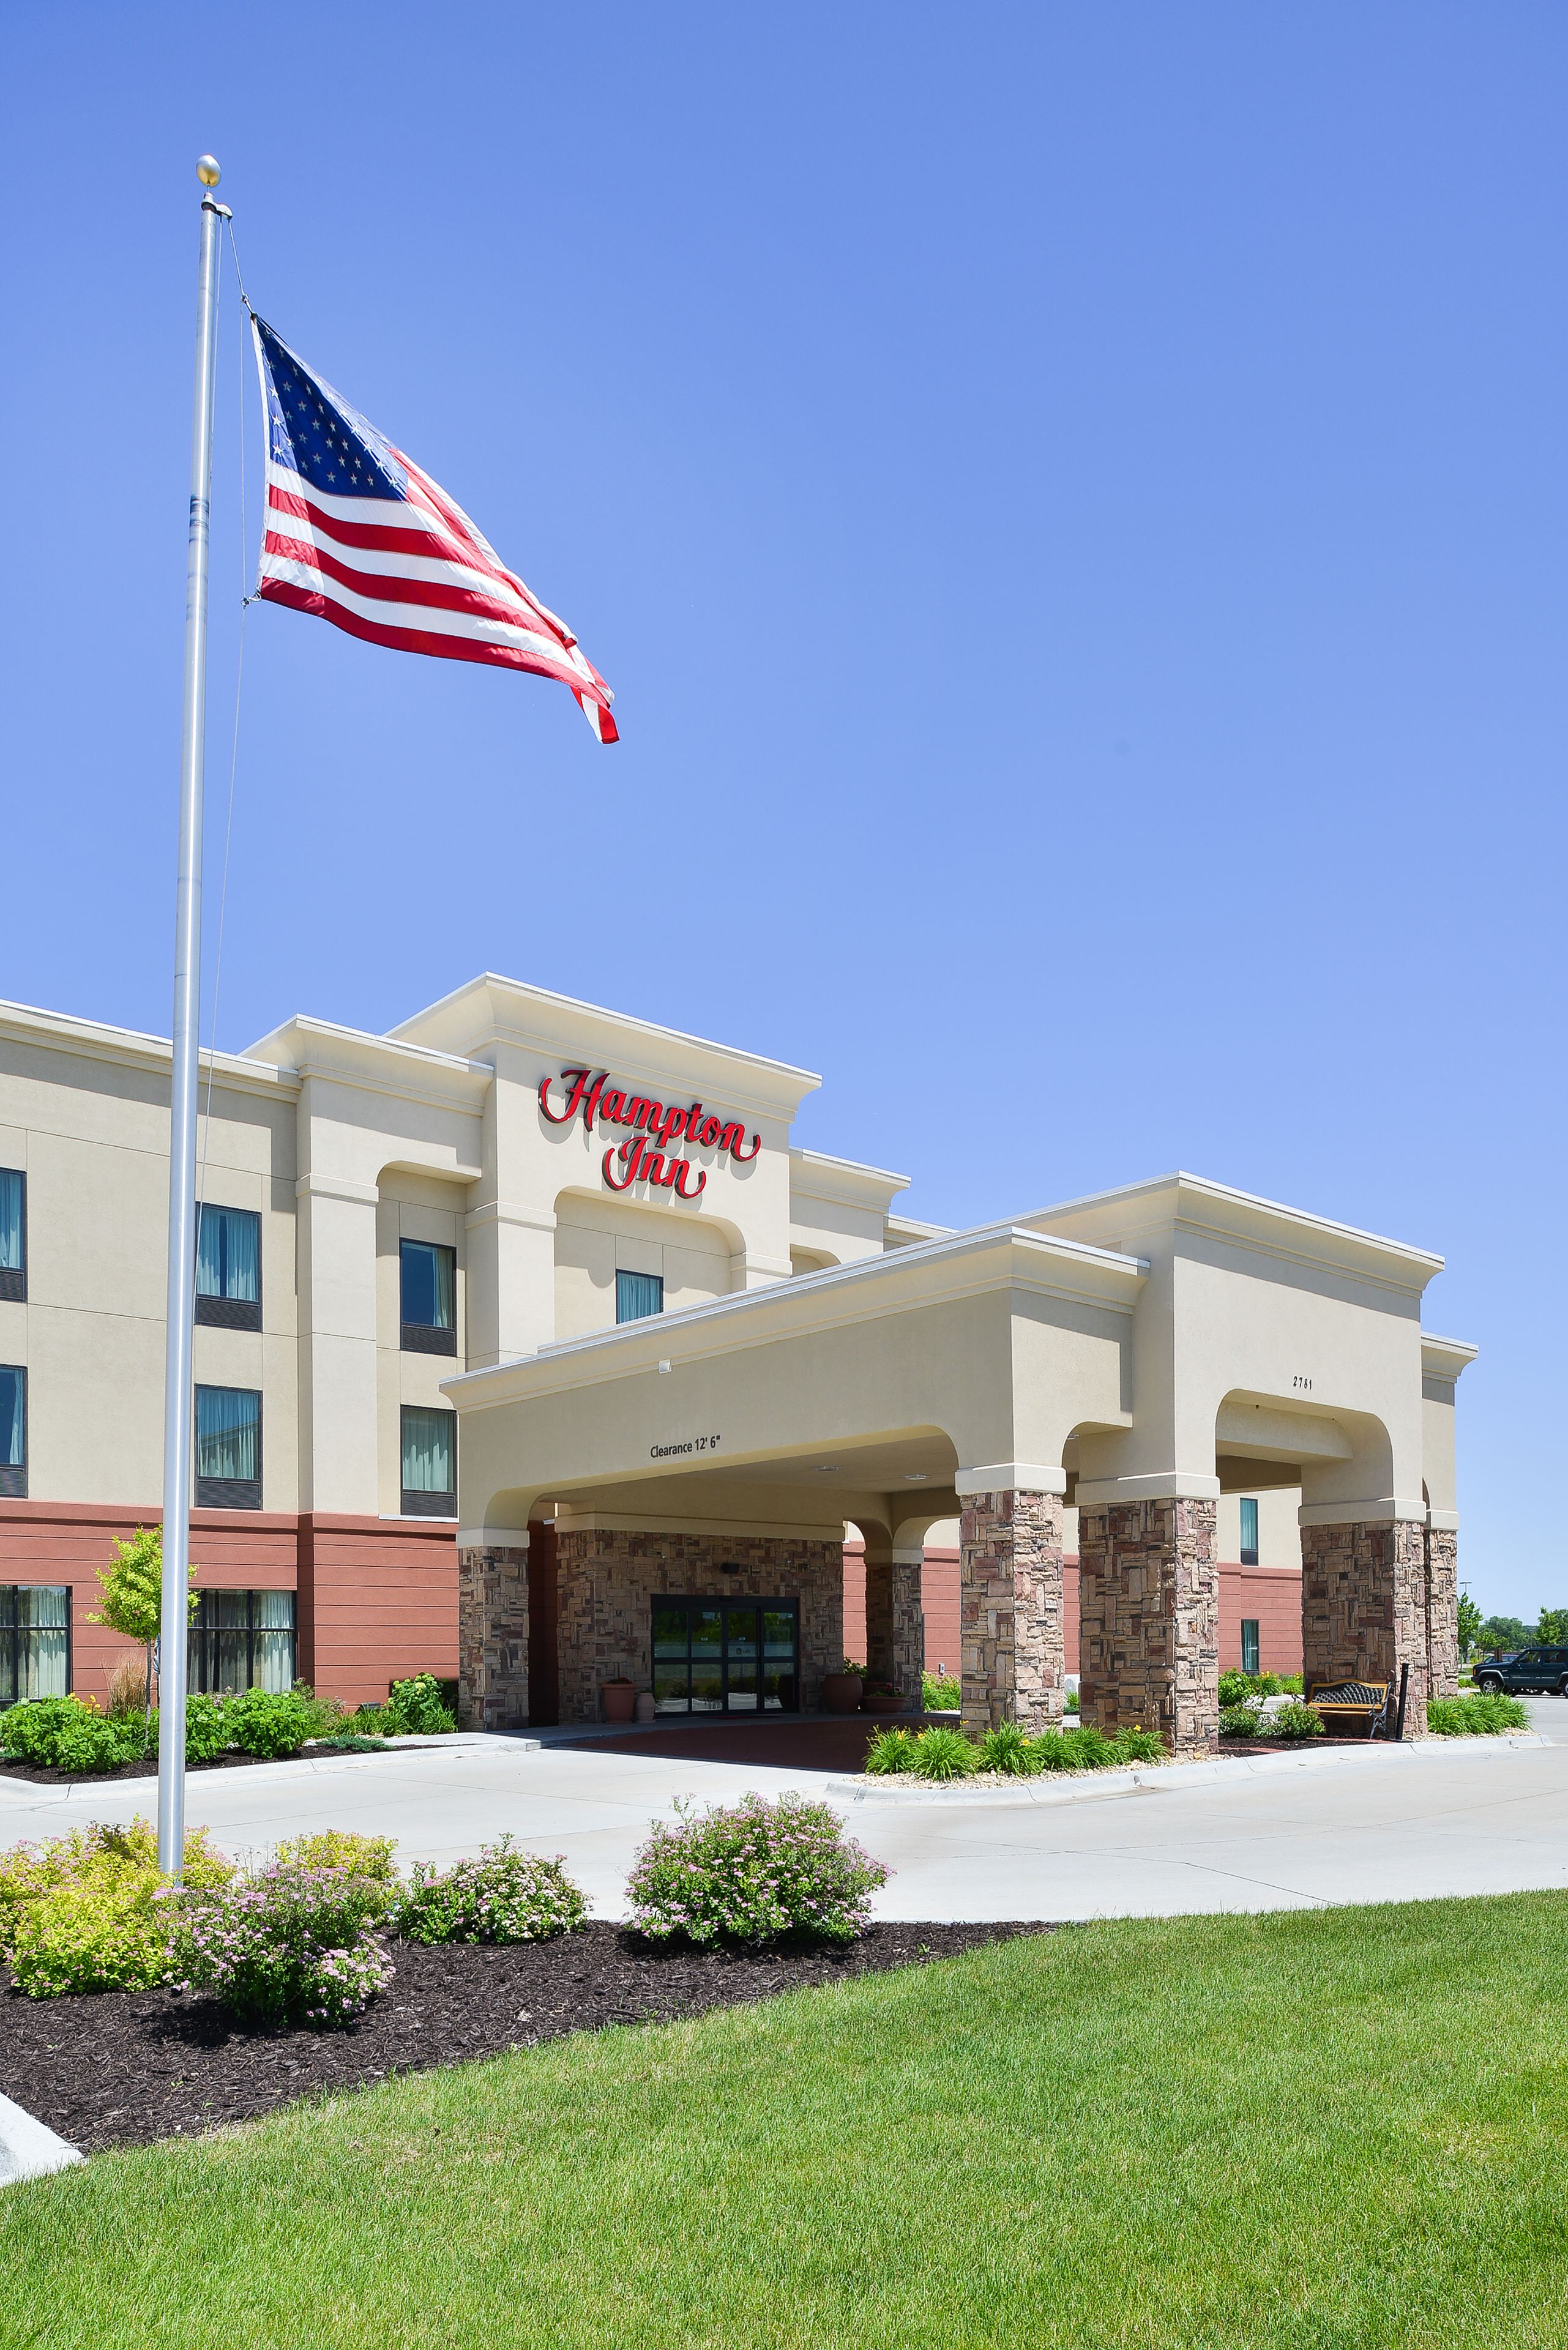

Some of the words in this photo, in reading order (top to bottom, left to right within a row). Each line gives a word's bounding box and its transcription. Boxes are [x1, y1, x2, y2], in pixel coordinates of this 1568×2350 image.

[539, 1069, 761, 1162] Hampton
[602, 1136, 706, 1199] Inn
[1293, 1375, 1312, 1391] 2781
[650, 1442, 693, 1458] Clearance
[695, 1437, 708, 1450] 12'
[710, 1434, 721, 1449] 6"
